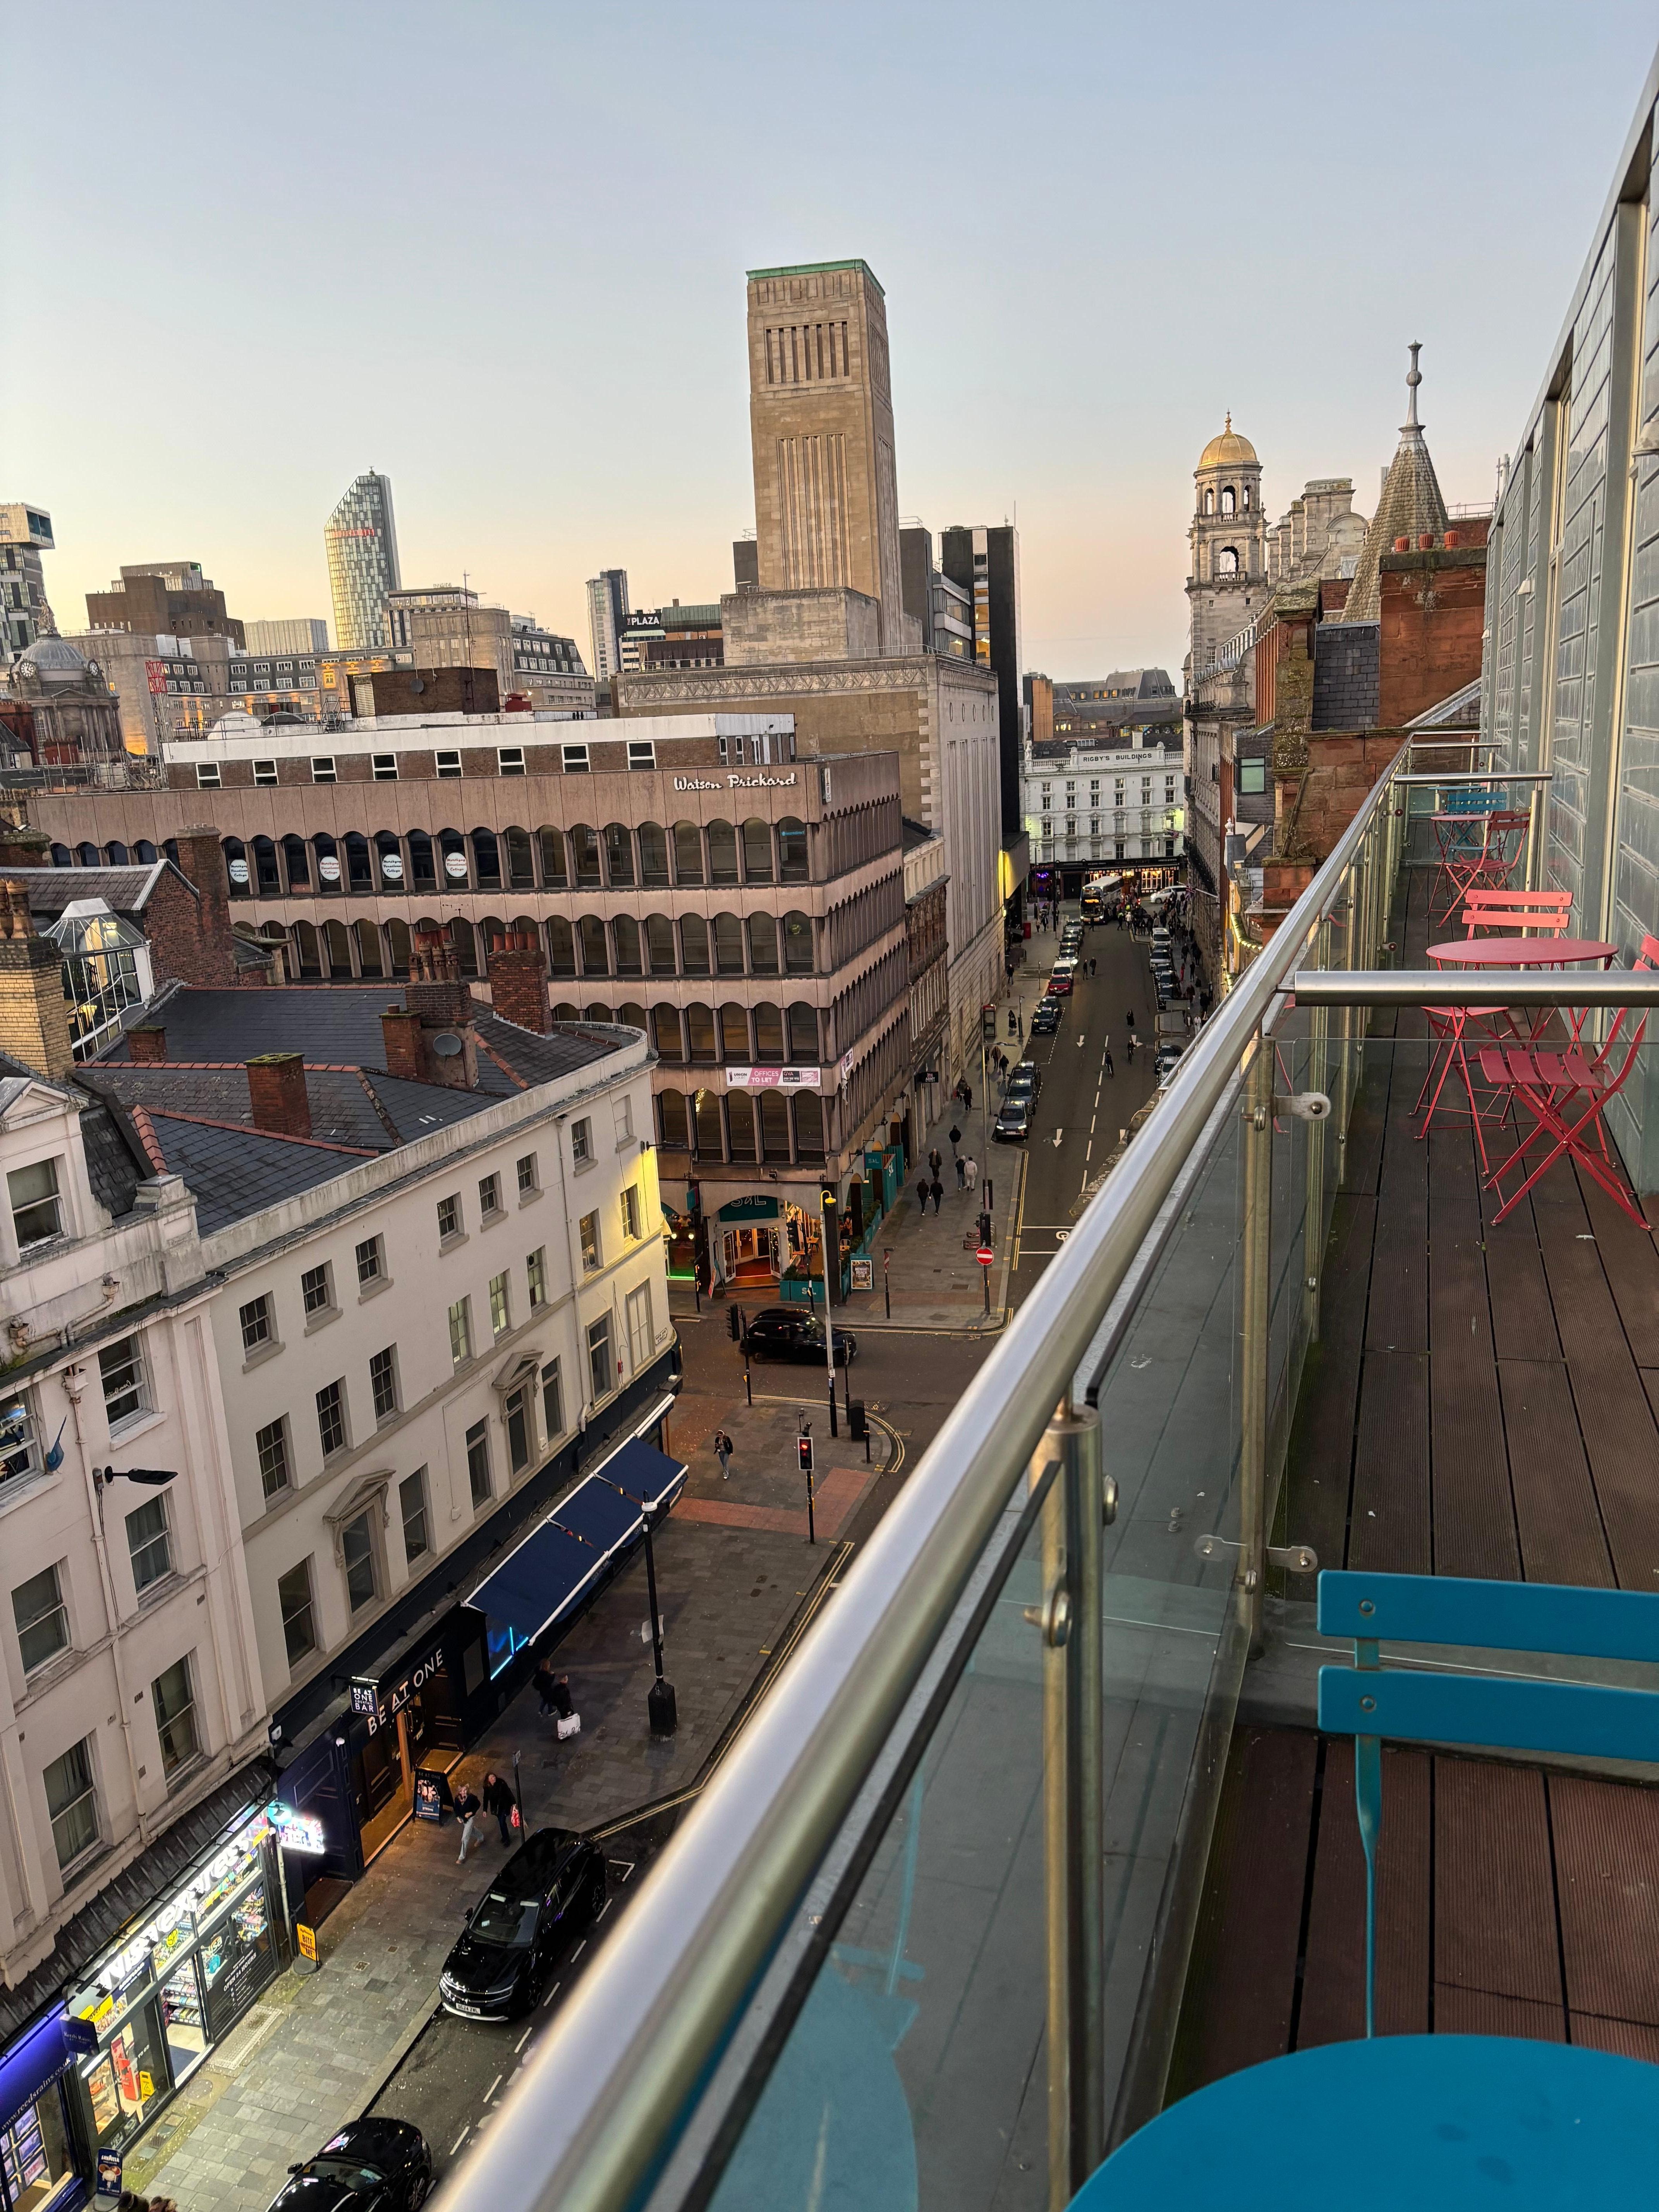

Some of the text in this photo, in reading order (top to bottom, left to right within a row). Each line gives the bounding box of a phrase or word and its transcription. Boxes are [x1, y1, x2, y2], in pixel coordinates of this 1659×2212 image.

[631, 617, 659, 625] PLAZA
[674, 773, 796, 790] Watson Prickard
[354, 1693, 373, 1702] ONE
[368, 1648, 443, 1737] BE AT ONE
[355, 1703, 374, 1712] BAR
[223, 1975, 236, 1992] OPEN
[241, 1952, 257, 1972] HOURS
[2, 2057, 71, 2130] www.reedsrains.co.uk
